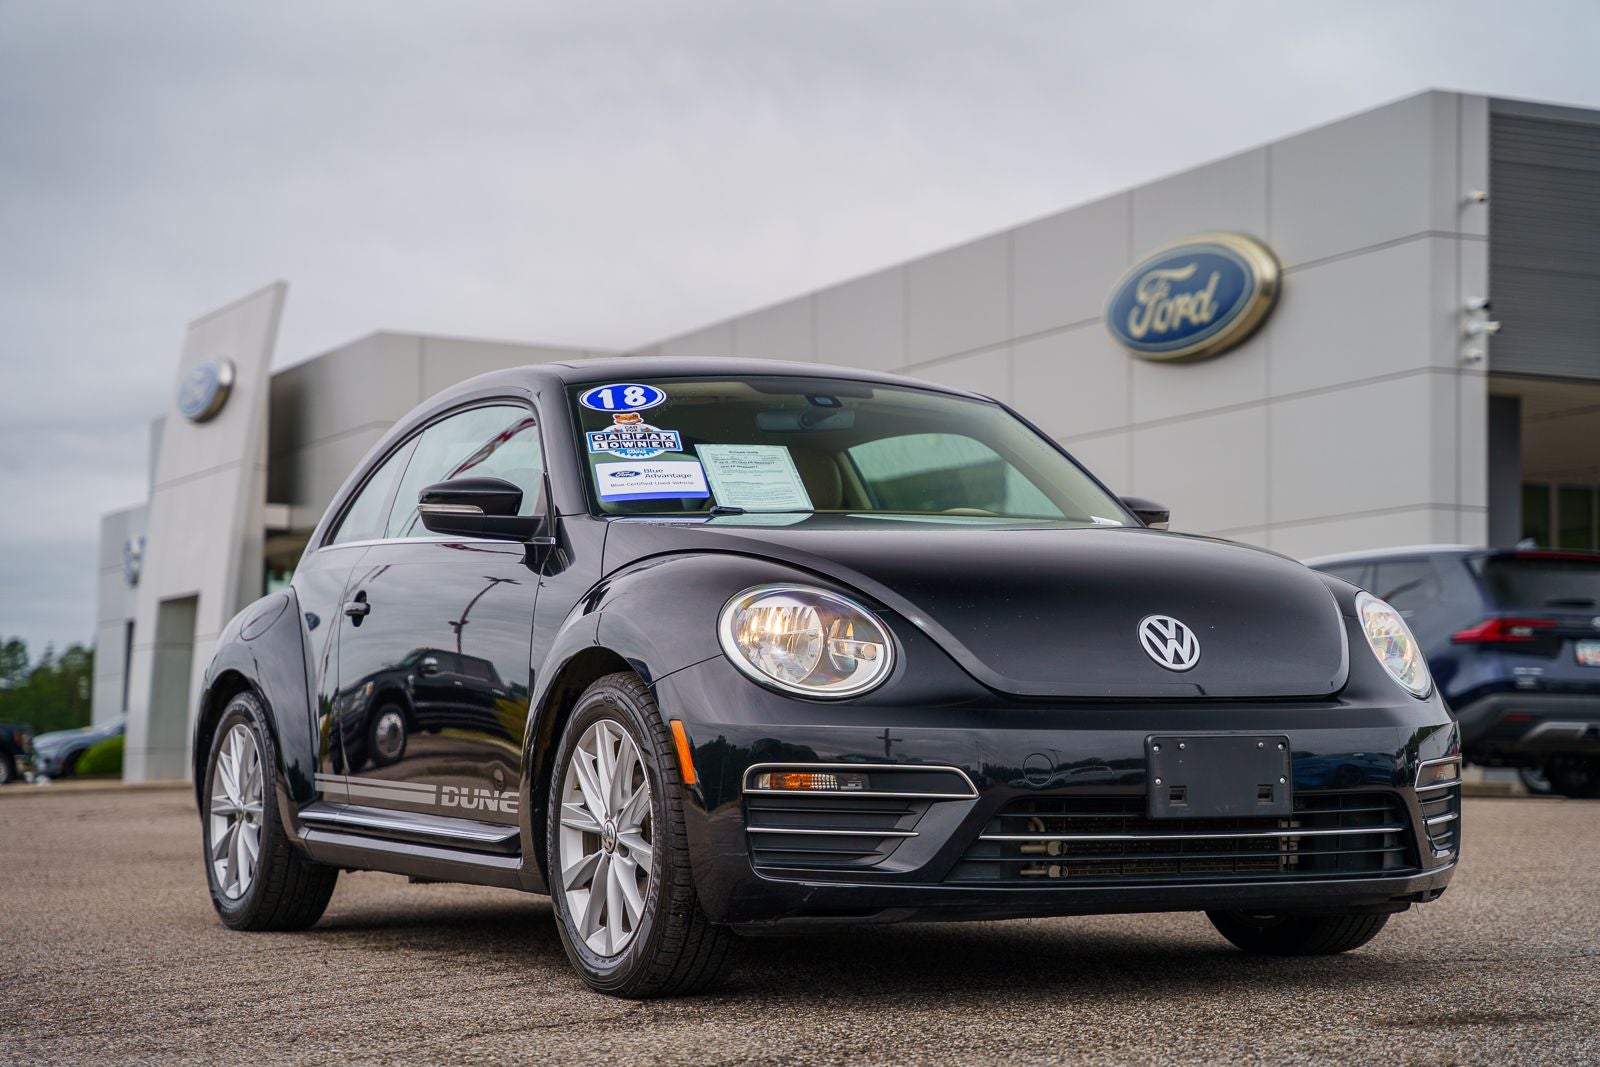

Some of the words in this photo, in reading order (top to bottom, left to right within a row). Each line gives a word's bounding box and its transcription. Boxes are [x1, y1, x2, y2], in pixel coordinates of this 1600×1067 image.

[1128, 262, 1220, 339] Ford
[594, 433, 673, 441] CARFAX
[441, 785, 520, 814] DUNE
